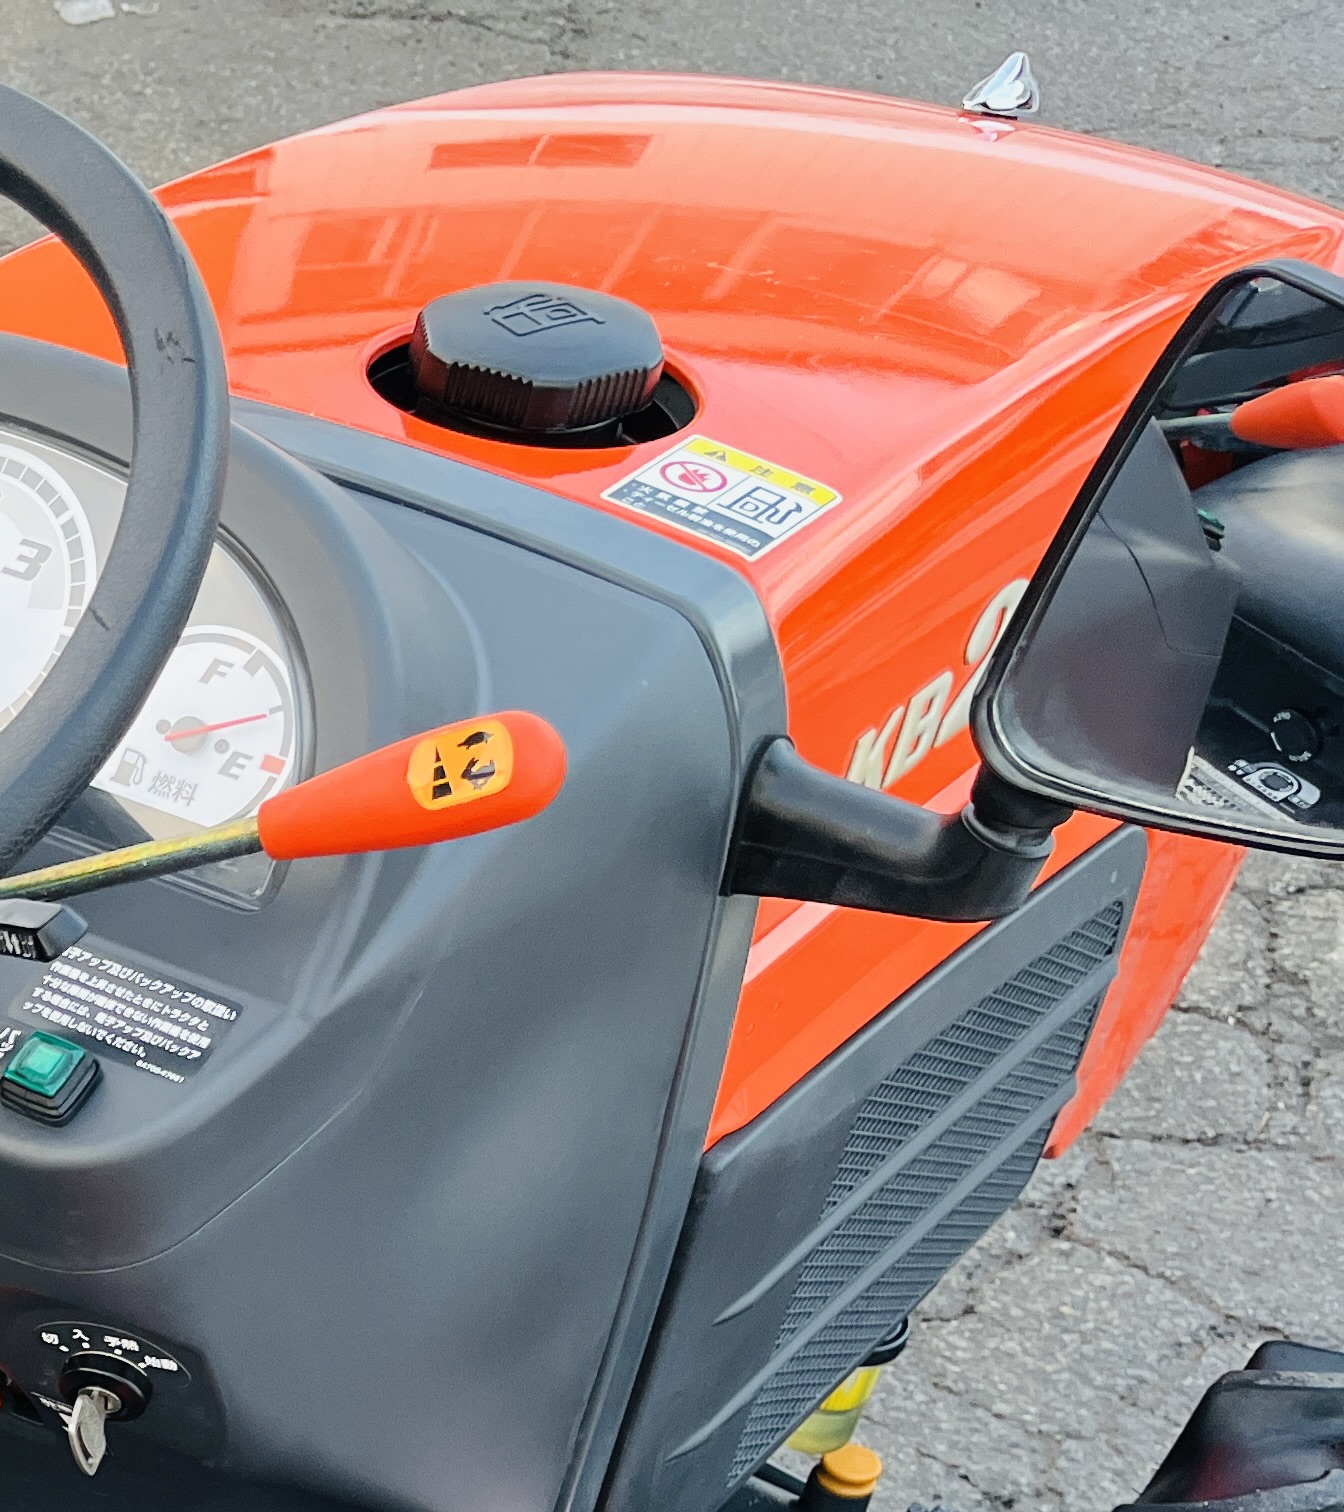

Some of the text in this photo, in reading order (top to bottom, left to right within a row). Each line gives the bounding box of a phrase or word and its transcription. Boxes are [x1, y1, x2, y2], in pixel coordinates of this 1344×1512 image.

[1, 538, 53, 582] 3
[199, 658, 234, 684] F
[218, 751, 253, 780] E
[147, 771, 199, 807] 燃料
